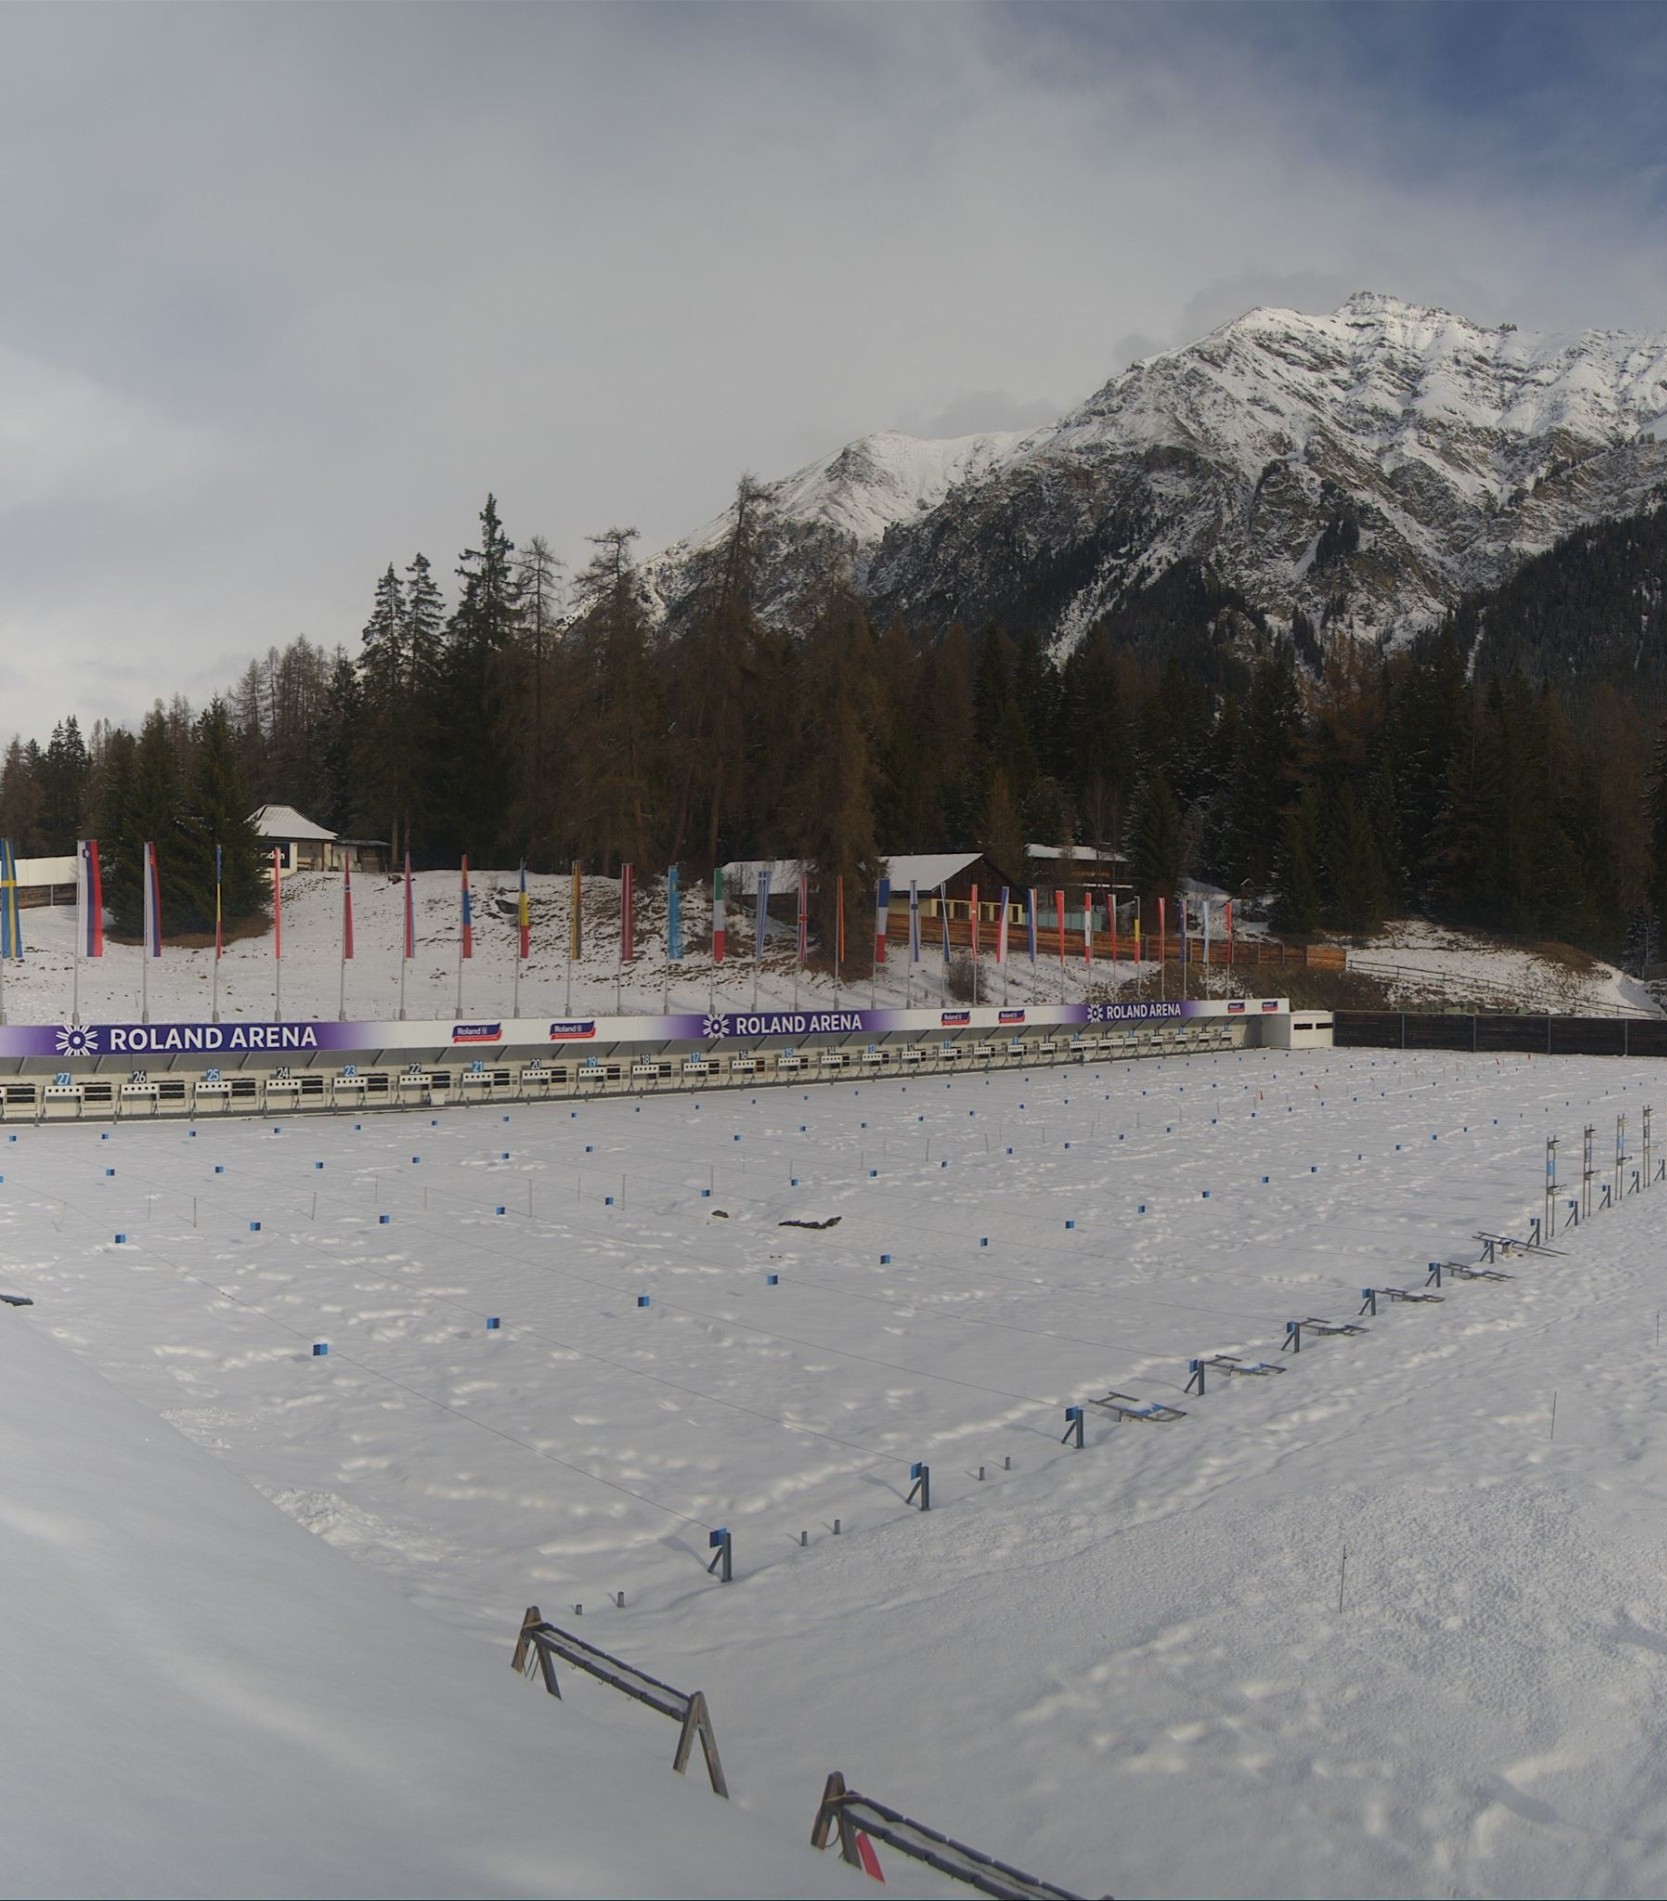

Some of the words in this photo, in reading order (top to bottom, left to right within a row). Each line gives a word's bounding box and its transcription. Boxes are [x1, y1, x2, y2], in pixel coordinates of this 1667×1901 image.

[1106, 1004, 1148, 1020] ROLAND
[1150, 1003, 1181, 1017] ARENA
[554, 1024, 577, 1032] Roland
[736, 1016, 806, 1035] ROLAND
[809, 1014, 863, 1031] ARENA
[457, 1027, 480, 1035] Roland
[109, 1027, 223, 1051] ROLAND
[229, 1026, 318, 1048] ARENA
[588, 1056, 597, 1067] 19
[641, 1054, 650, 1064] 18
[691, 1052, 699, 1062] 17
[409, 1063, 421, 1074] 22
[473, 1061, 484, 1072] 21
[531, 1058, 542, 1069] 20
[207, 1069, 219, 1081] 25
[277, 1067, 290, 1079] 24
[344, 1065, 356, 1077] 23
[56, 1073, 71, 1085] 27
[133, 1071, 147, 1083] 26
